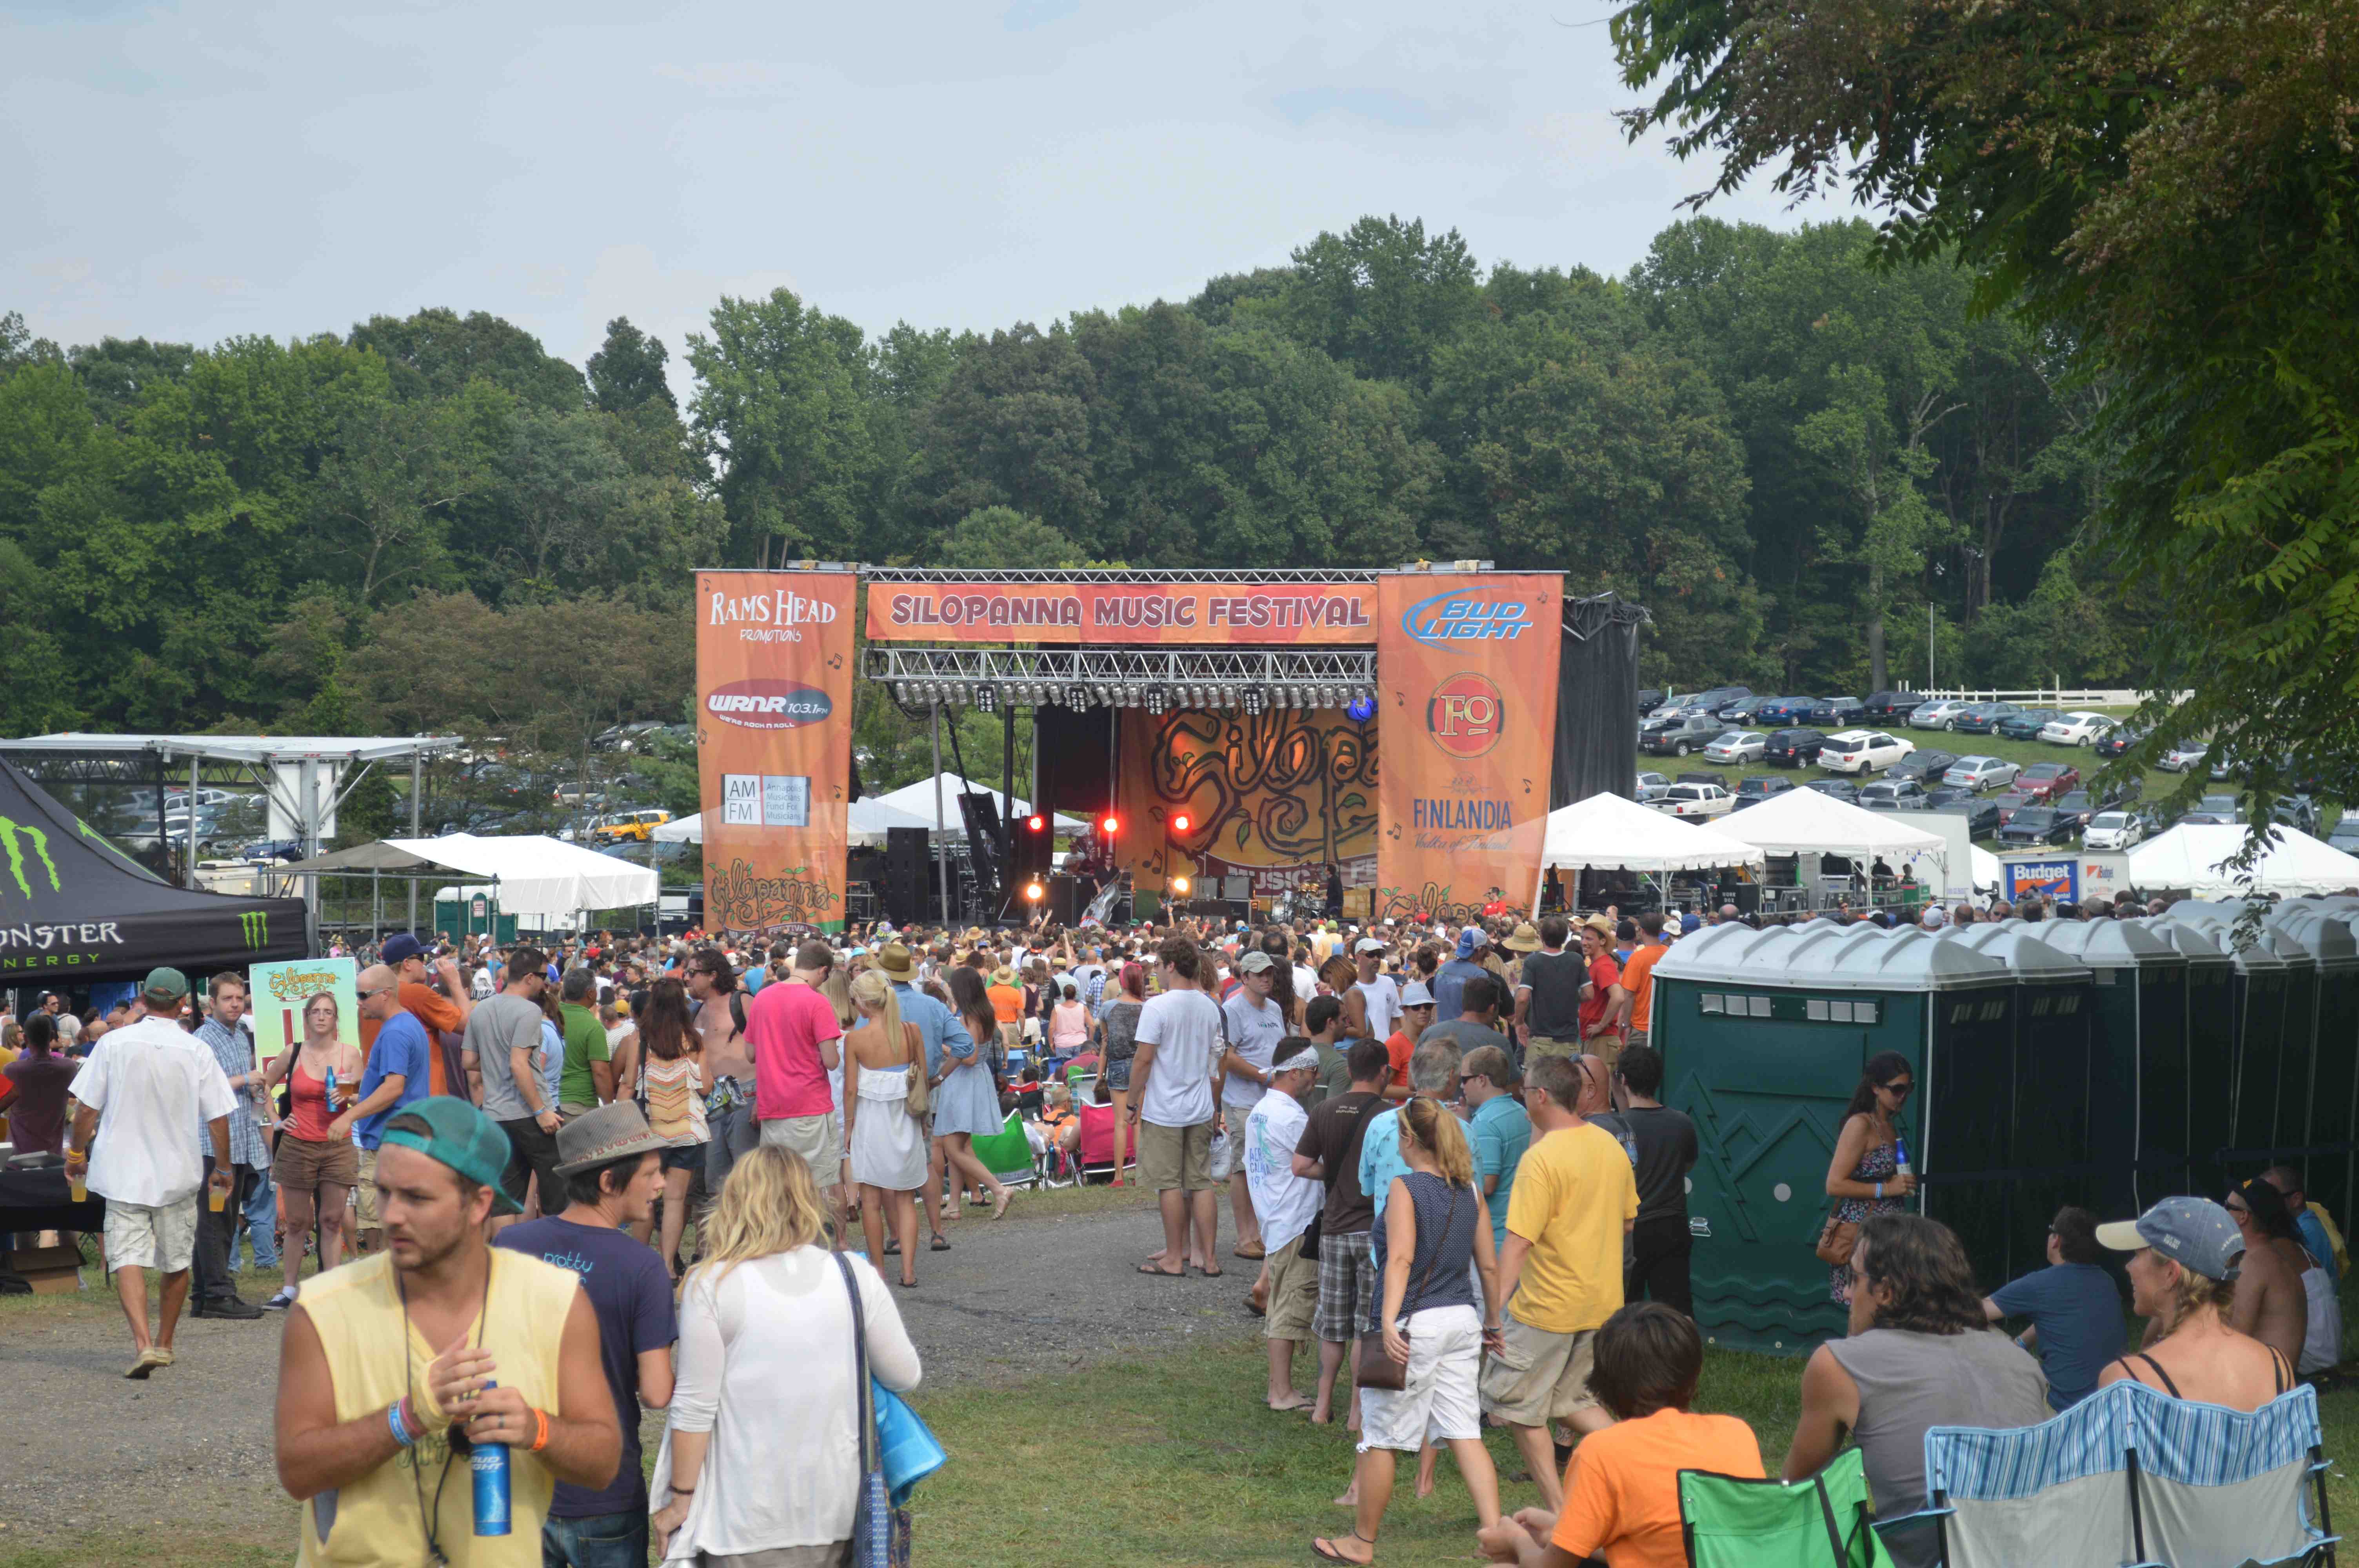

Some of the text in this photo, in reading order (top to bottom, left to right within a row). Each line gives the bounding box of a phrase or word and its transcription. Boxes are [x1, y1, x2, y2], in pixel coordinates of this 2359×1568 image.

[709, 589, 836, 625] RAMS HEAD
[890, 593, 1370, 628] SILOPANNA MUSIC FESTIVAL
[1439, 600, 1526, 620] BUD
[740, 629, 802, 644] PROMOTIONS
[1418, 619, 1533, 639] LIGHT
[730, 780, 755, 797] AM
[766, 784, 802, 792] Annapolis
[766, 793, 800, 801] Musicians
[729, 803, 752, 820] FM
[1414, 799, 1512, 830] FINLANDIA
[1414, 832, 1448, 848] Vodka
[2014, 864, 2070, 882] Budget
[4, 953, 100, 968] NERGY
